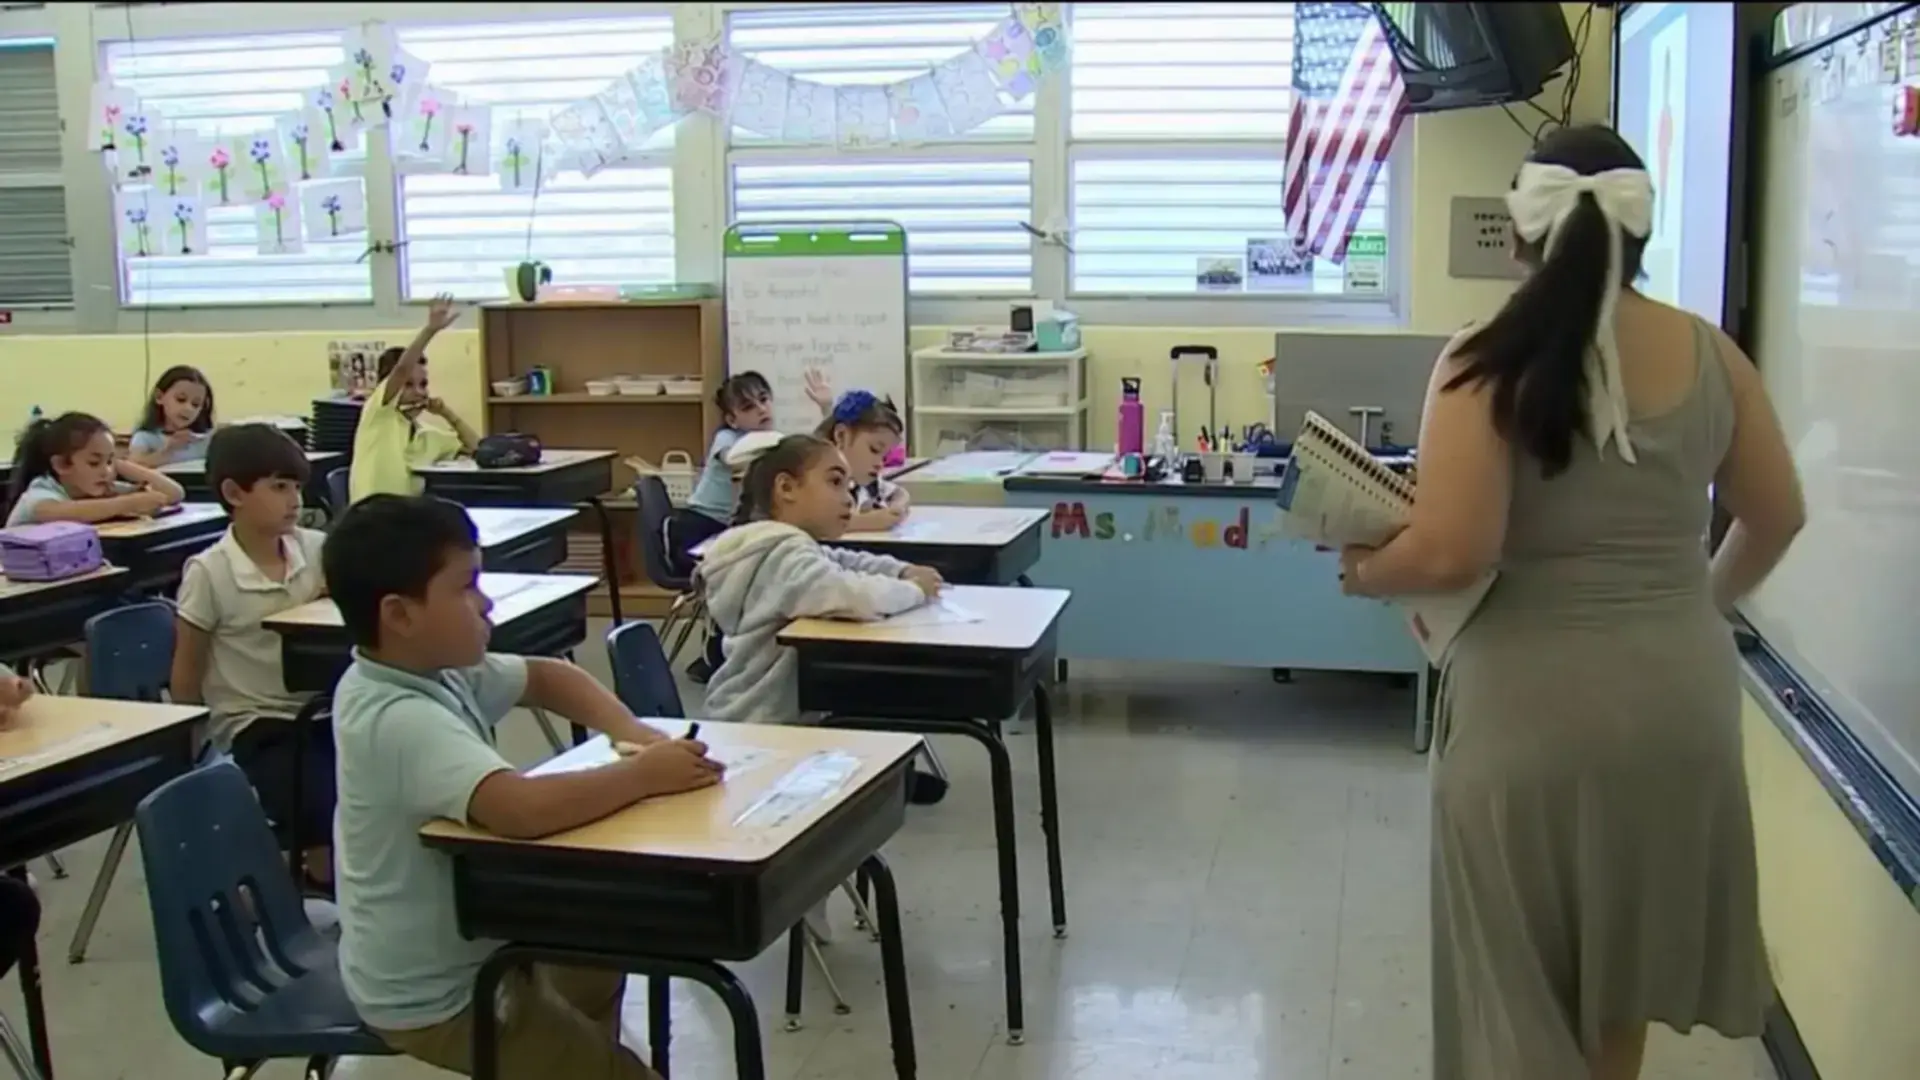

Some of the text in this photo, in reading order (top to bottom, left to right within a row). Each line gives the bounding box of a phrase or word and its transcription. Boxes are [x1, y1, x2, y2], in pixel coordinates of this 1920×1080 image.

[1476, 239, 1504, 248] THIS
[1051, 502, 1270, 552] Ms. Mad
